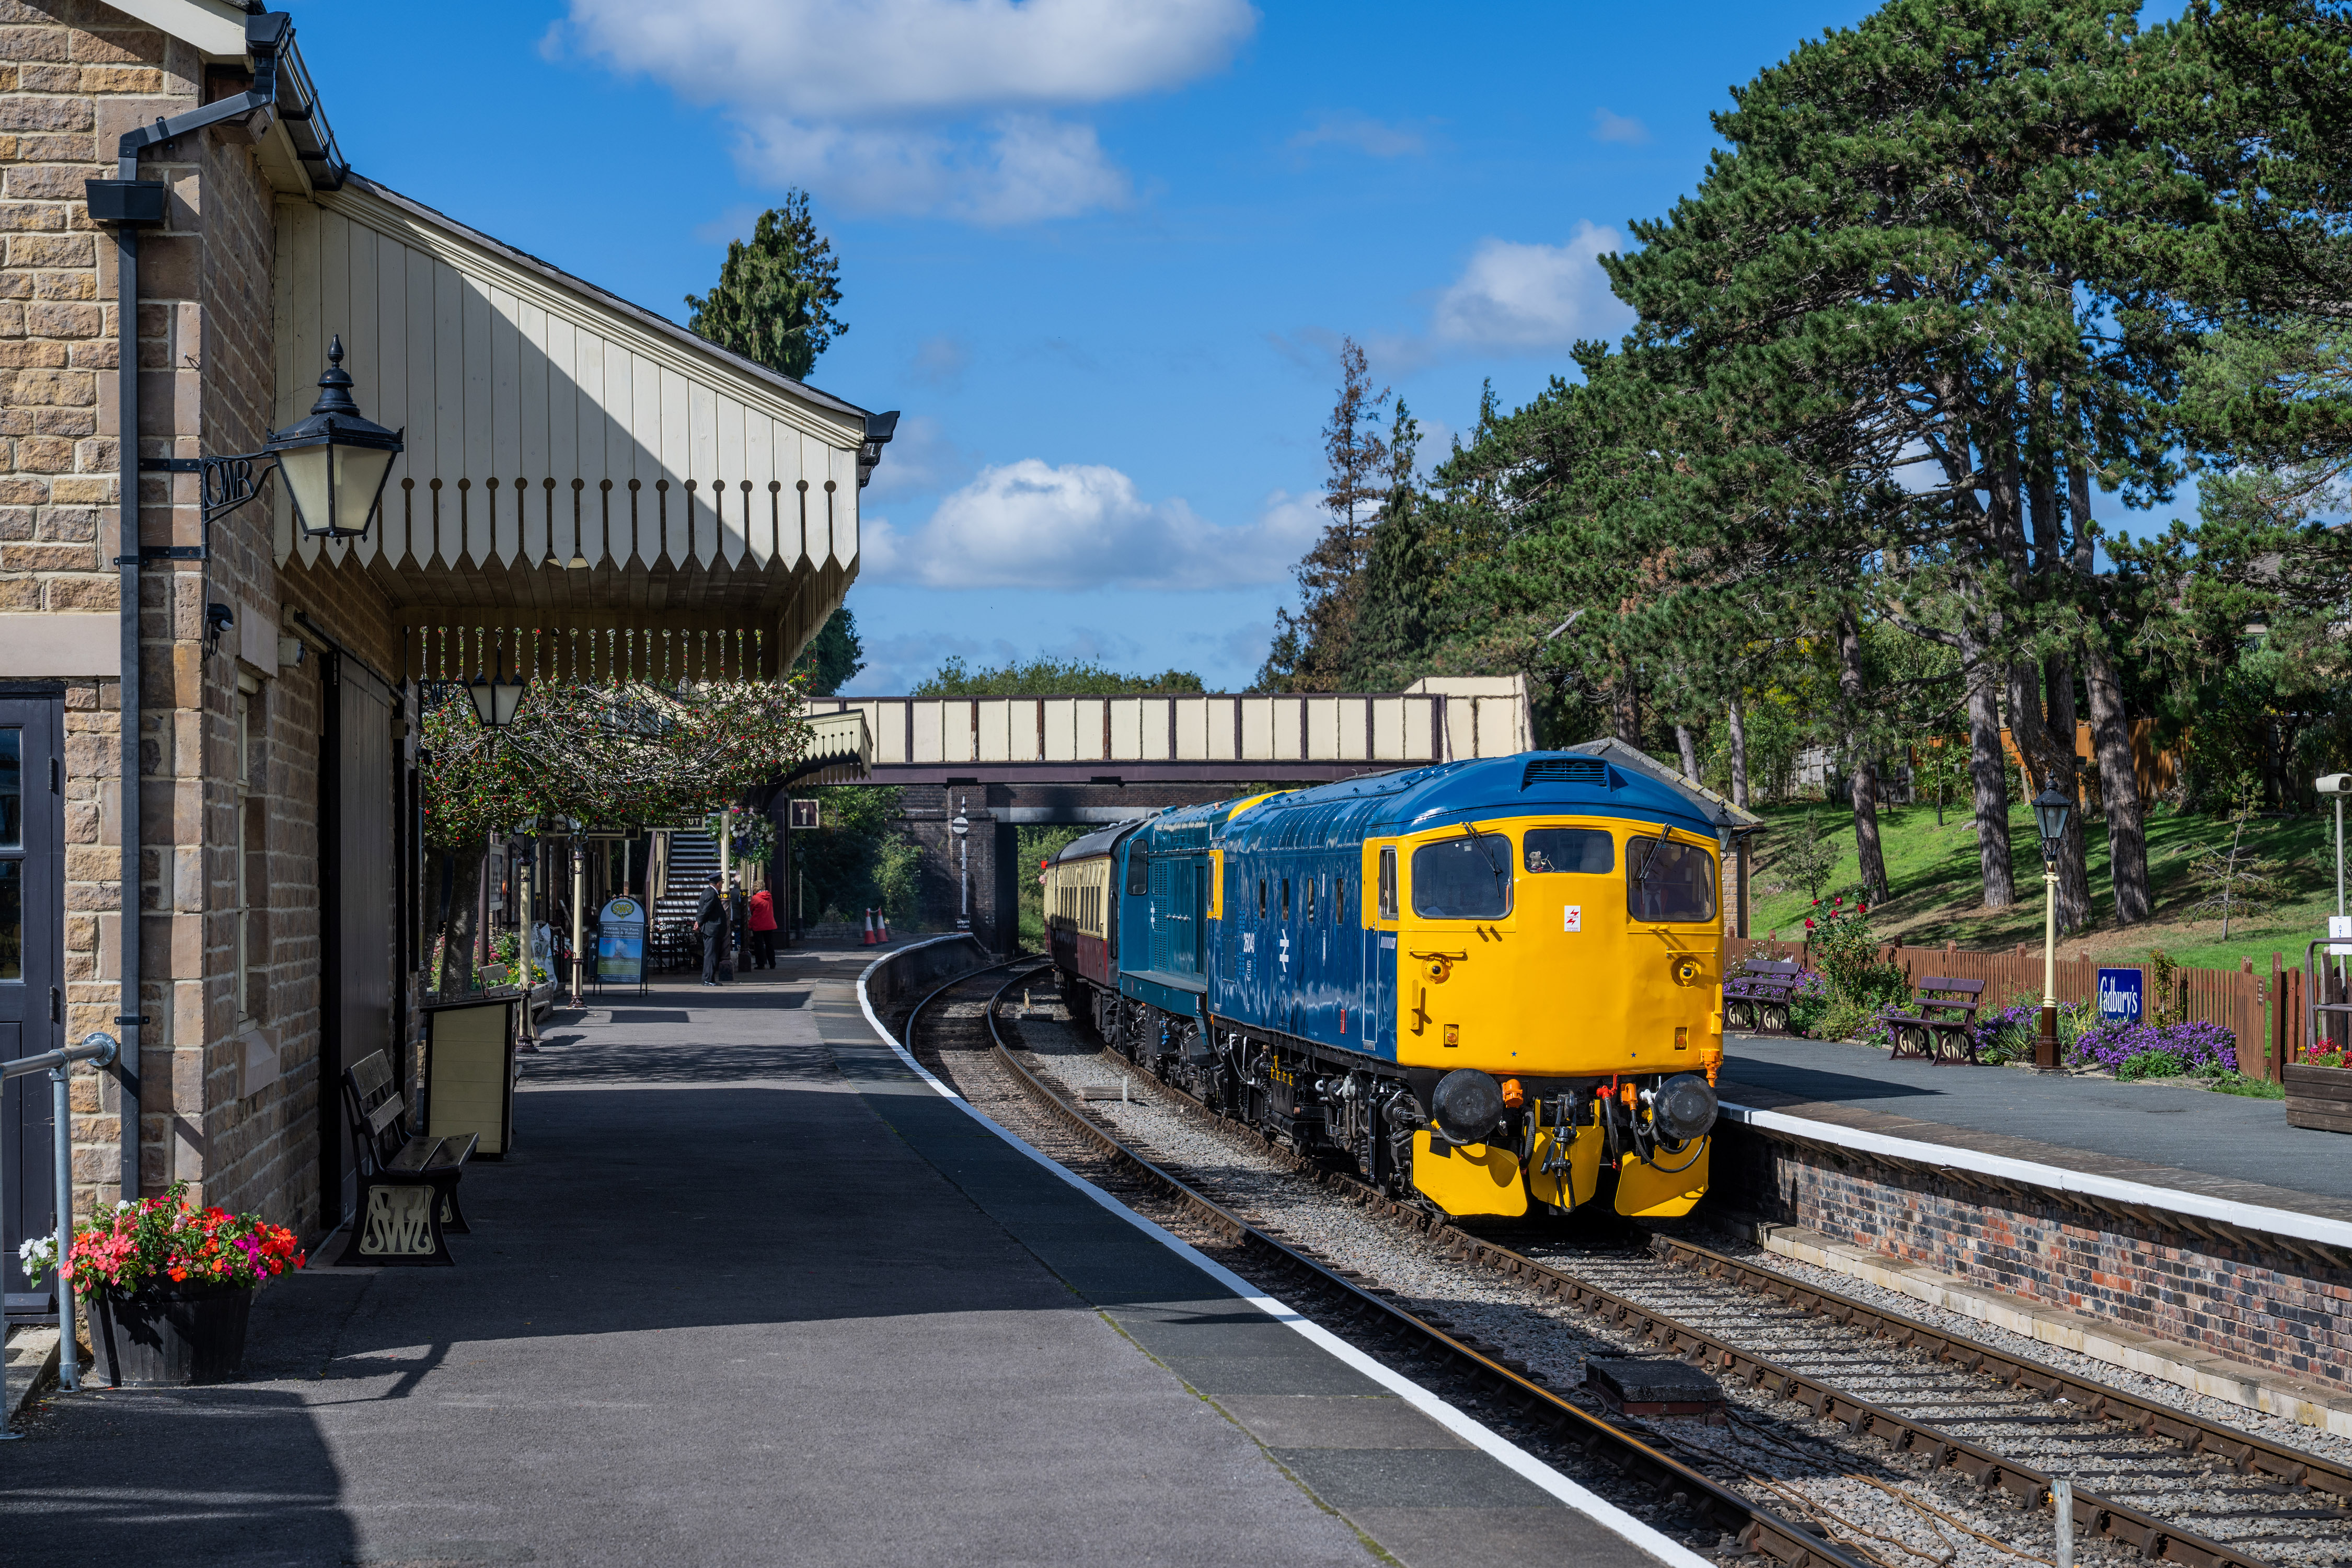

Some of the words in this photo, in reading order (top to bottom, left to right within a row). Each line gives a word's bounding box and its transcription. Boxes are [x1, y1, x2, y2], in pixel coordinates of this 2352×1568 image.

[801, 809, 806, 825] 1
[1243, 932, 1254, 953] 26043
[2099, 976, 2138, 1022] Cadbury's
[1728, 1004, 1751, 1025] GWR
[1763, 1008, 1787, 1030] GWR
[1899, 1028, 1925, 1054] GWR
[1942, 1033, 1969, 1059] GWR
